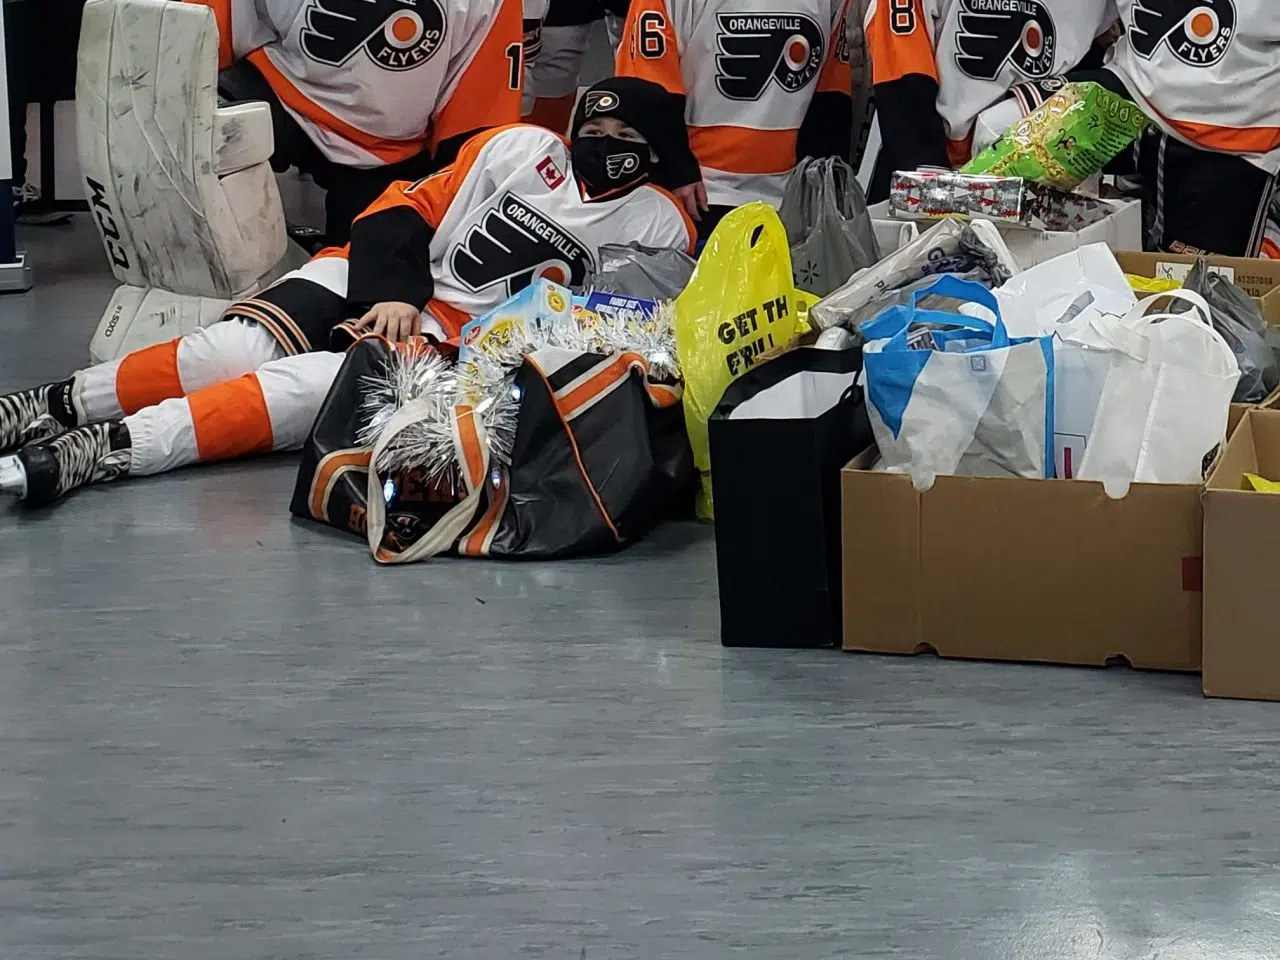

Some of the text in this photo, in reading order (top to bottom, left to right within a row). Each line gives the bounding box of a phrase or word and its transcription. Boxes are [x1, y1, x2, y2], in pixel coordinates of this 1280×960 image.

[376, 28, 440, 66] FLYERS
[630, 10, 667, 63] 6
[729, 18, 801, 31] ORANGEVILLE
[1178, 26, 1231, 62] FLYERS
[505, 43, 523, 90] 1
[785, 45, 821, 88] FLYERS
[1023, 35, 1053, 73] FLYERS
[86, 175, 130, 270] CCM
[507, 203, 581, 261] ORANGEVILLE
[717, 295, 789, 346] GET TH
